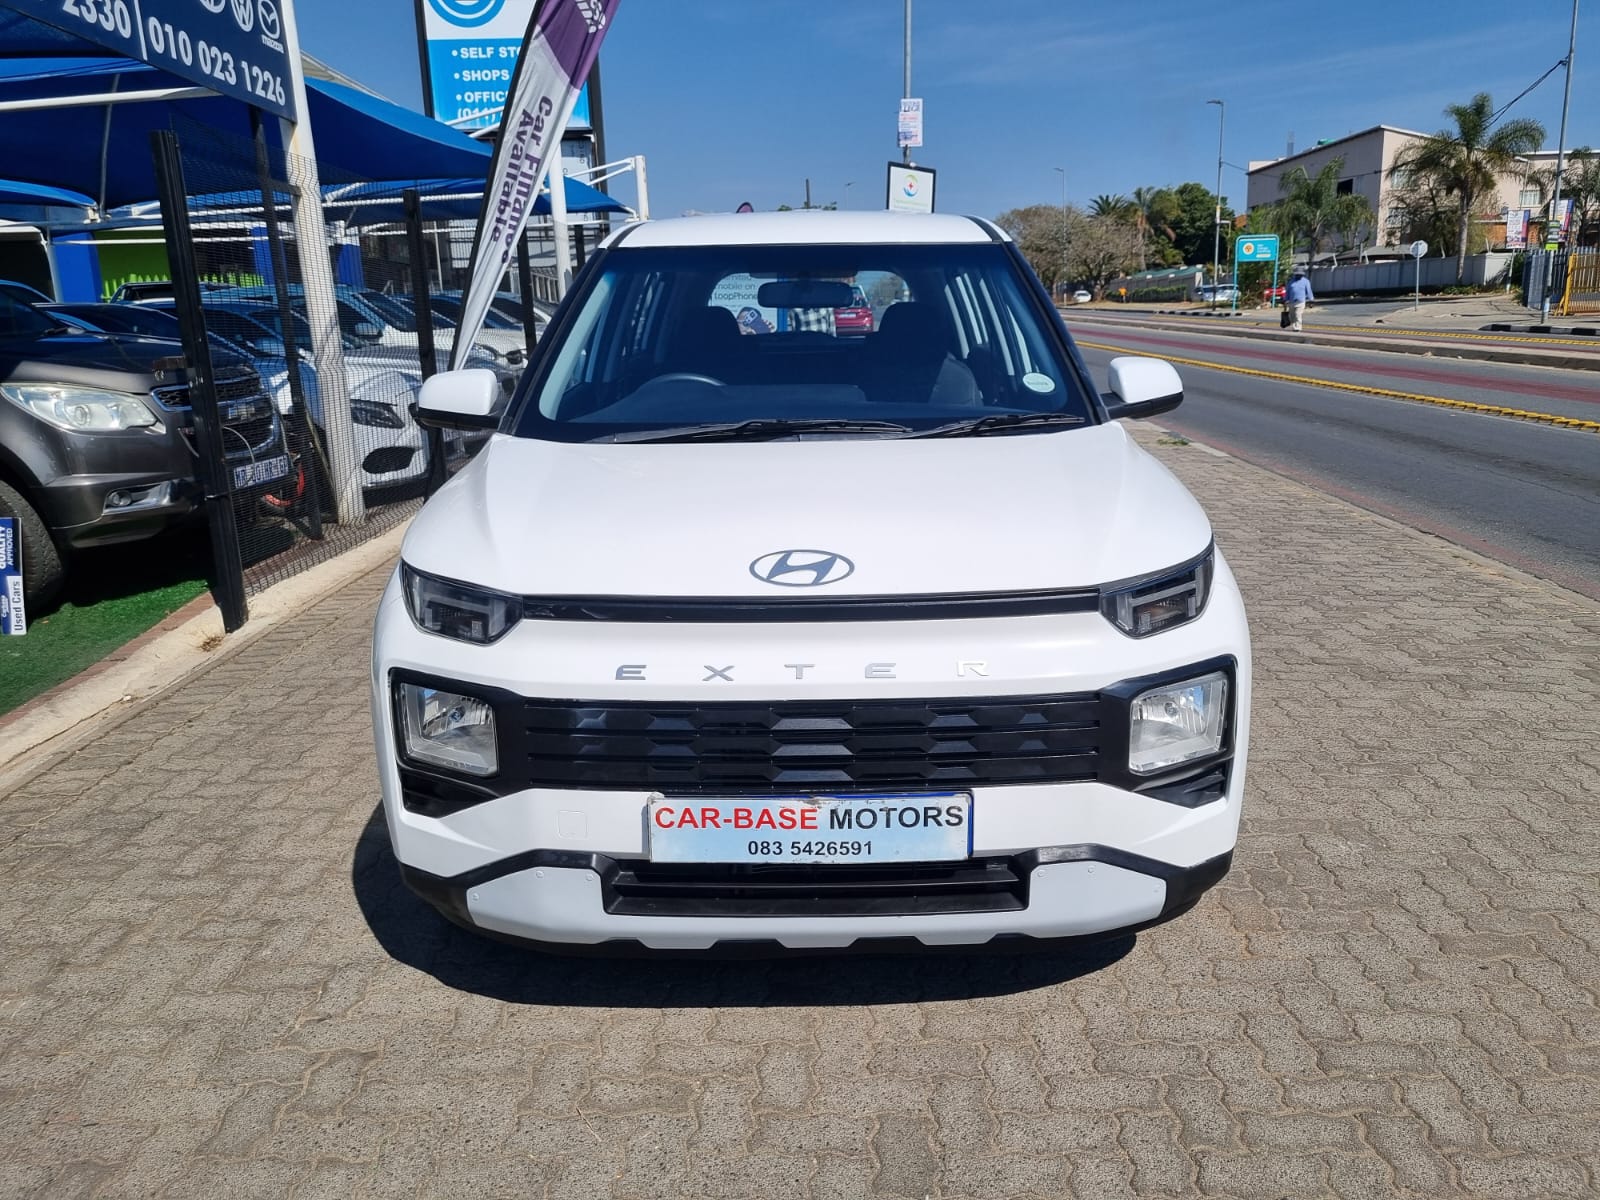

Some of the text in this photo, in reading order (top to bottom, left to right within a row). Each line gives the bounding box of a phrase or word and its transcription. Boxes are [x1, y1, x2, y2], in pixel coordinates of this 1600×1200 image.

[148, 17, 286, 107] 010 023 1226
[460, 46, 494, 59] SELF
[462, 69, 510, 82] SHOPS
[529, 95, 553, 147] Car
[491, 108, 535, 244] Available
[12, 580, 24, 632] Used Cars
[615, 660, 990, 682] EXTER
[654, 805, 965, 831] CAR-BASE MOTORS
[747, 840, 873, 856] 083 5426591
